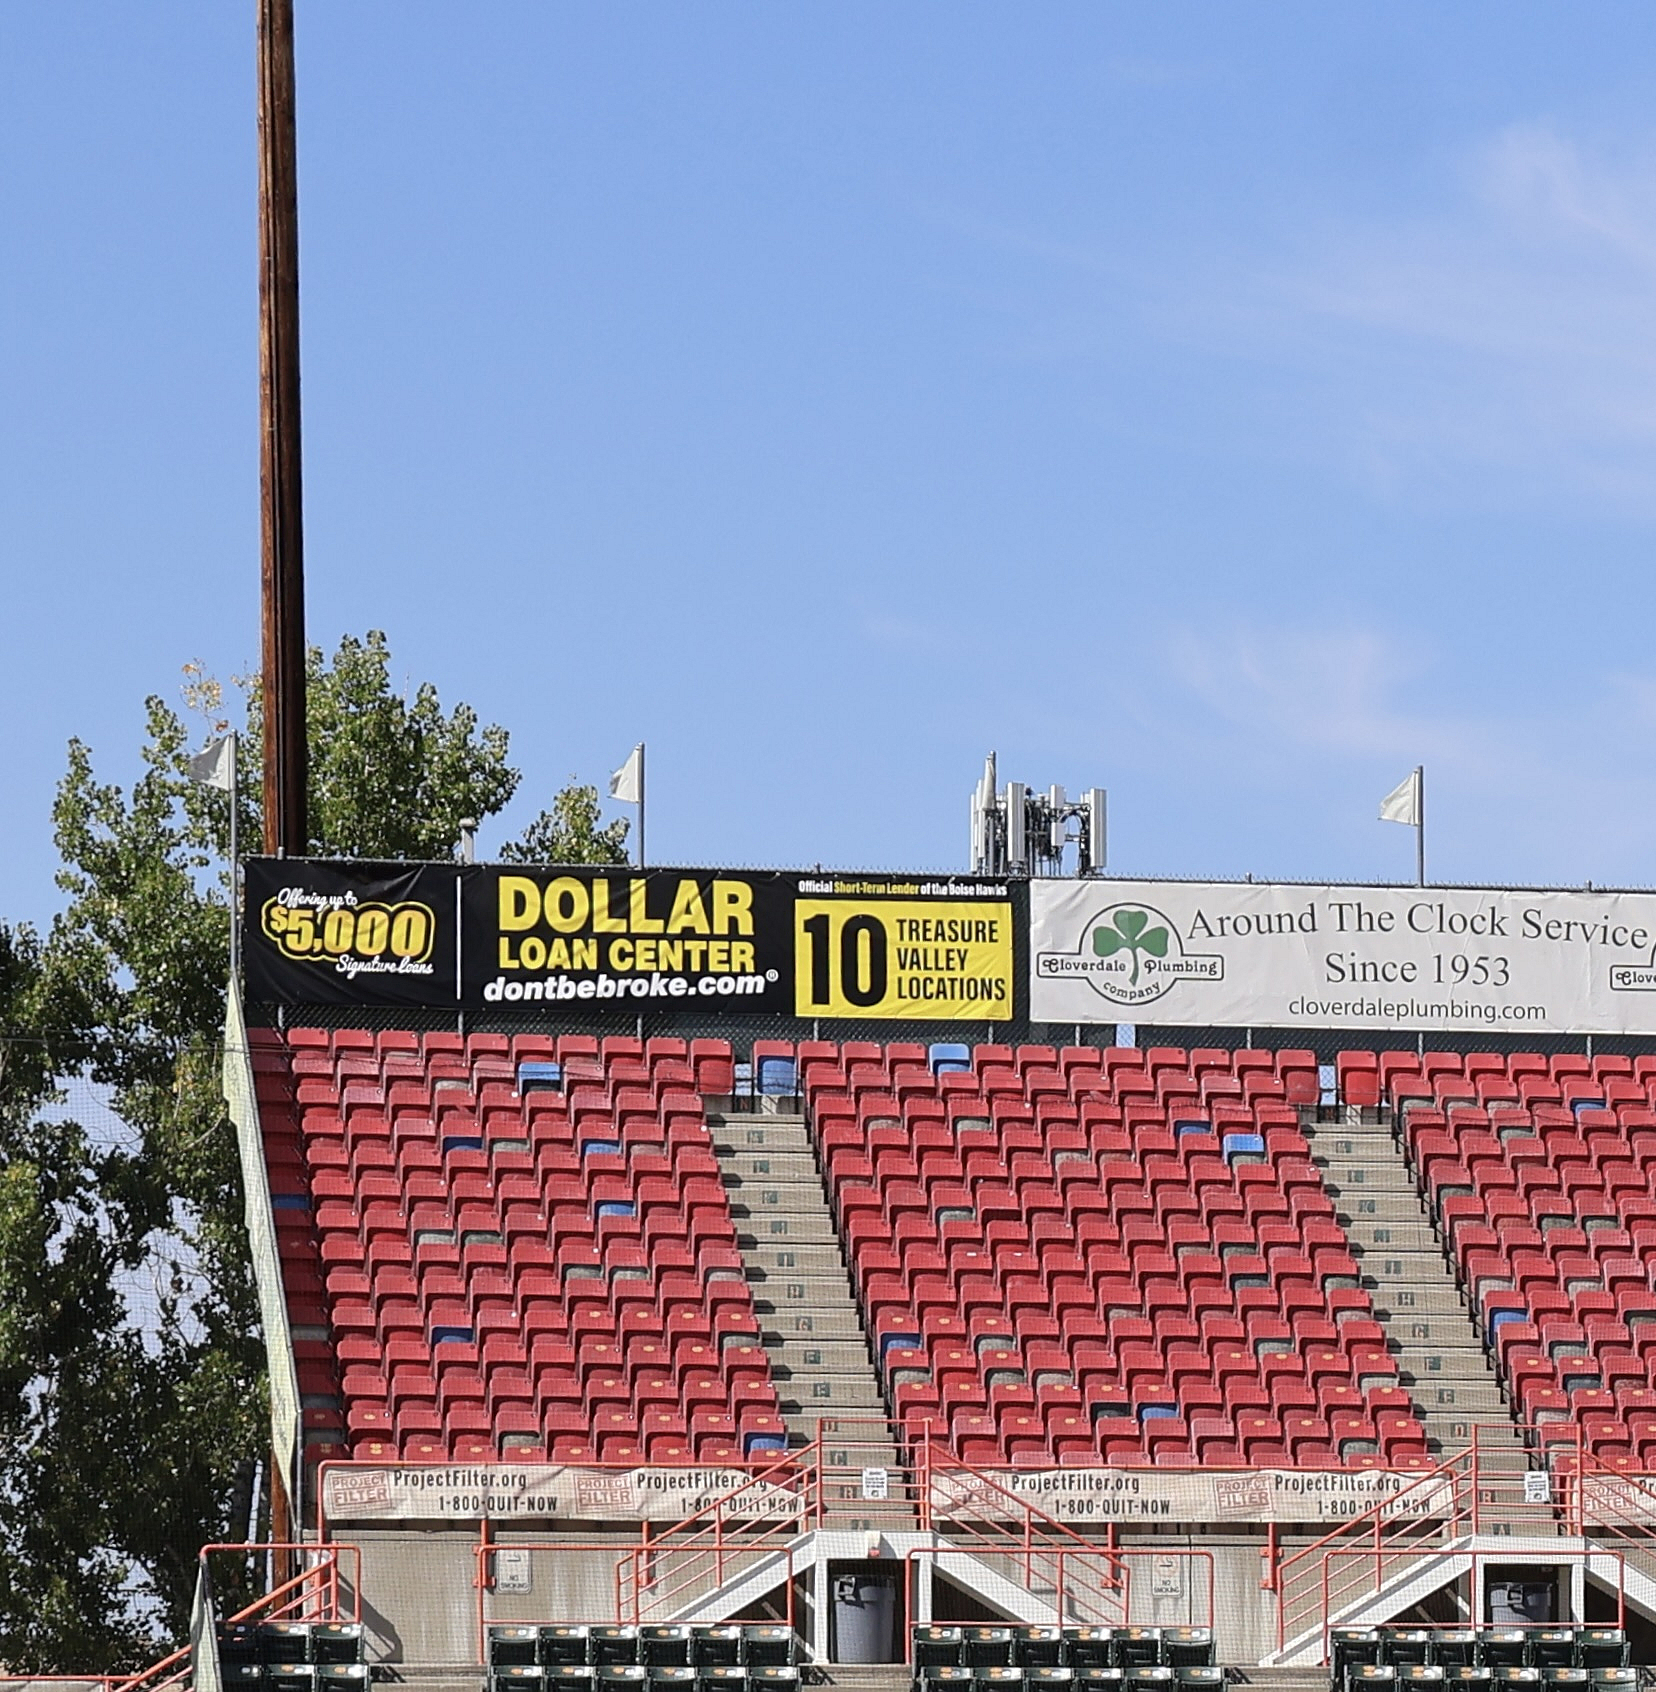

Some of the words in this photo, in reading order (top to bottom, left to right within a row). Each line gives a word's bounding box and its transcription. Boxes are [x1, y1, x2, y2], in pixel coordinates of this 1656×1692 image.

[798, 880, 833, 894] Official
[834, 881, 885, 894] Short-Term
[887, 882, 919, 895] Lender
[920, 882, 932, 895] of
[932, 883, 948, 895] the
[949, 883, 975, 896] Boise
[975, 884, 1007, 896] Hawks
[277, 887, 329, 912] Offering
[330, 893, 344, 910] up
[343, 890, 358, 906] to
[498, 876, 755, 935] DOLLAR
[270, 905, 426, 957] $5,000
[896, 918, 998, 943] TREASURE
[1186, 903, 1318, 939] Around
[1328, 903, 1395, 932] The
[1407, 903, 1509, 936] Clock
[1522, 909, 1648, 949] Service
[499, 937, 598, 970] LOAN
[608, 938, 755, 973] CENTER
[803, 913, 887, 1007] 10
[896, 948, 968, 971] VALLEY
[336, 954, 398, 980] Signature
[1042, 957, 1126, 973] Cloverdale
[1144, 959, 1217, 975] Plumbing
[1325, 952, 1418, 983] Since
[1432, 953, 1510, 986] 1953
[897, 976, 1005, 1000] LOCATIONS
[1103, 981, 1161, 1000] company
[1289, 996, 1546, 1023] cloverdaleplumbing.com
[332, 1476, 386, 1488] PROJECT
[393, 1470, 527, 1490] ProjectFilter.org
[576, 1476, 629, 1489] PROJECT
[1012, 1475, 1140, 1493] ProjectFilter.org
[1216, 1479, 1267, 1491] PROJECT
[1275, 1475, 1400, 1494] ProjectFilter.org
[334, 1488, 387, 1504] FILTER
[439, 1495, 558, 1511] 1-800-QUIT-NOW
[578, 1489, 631, 1504] FILTER
[1219, 1492, 1268, 1507] FILTER
[1055, 1499, 1170, 1515] 1-800-QUIT-NOW
